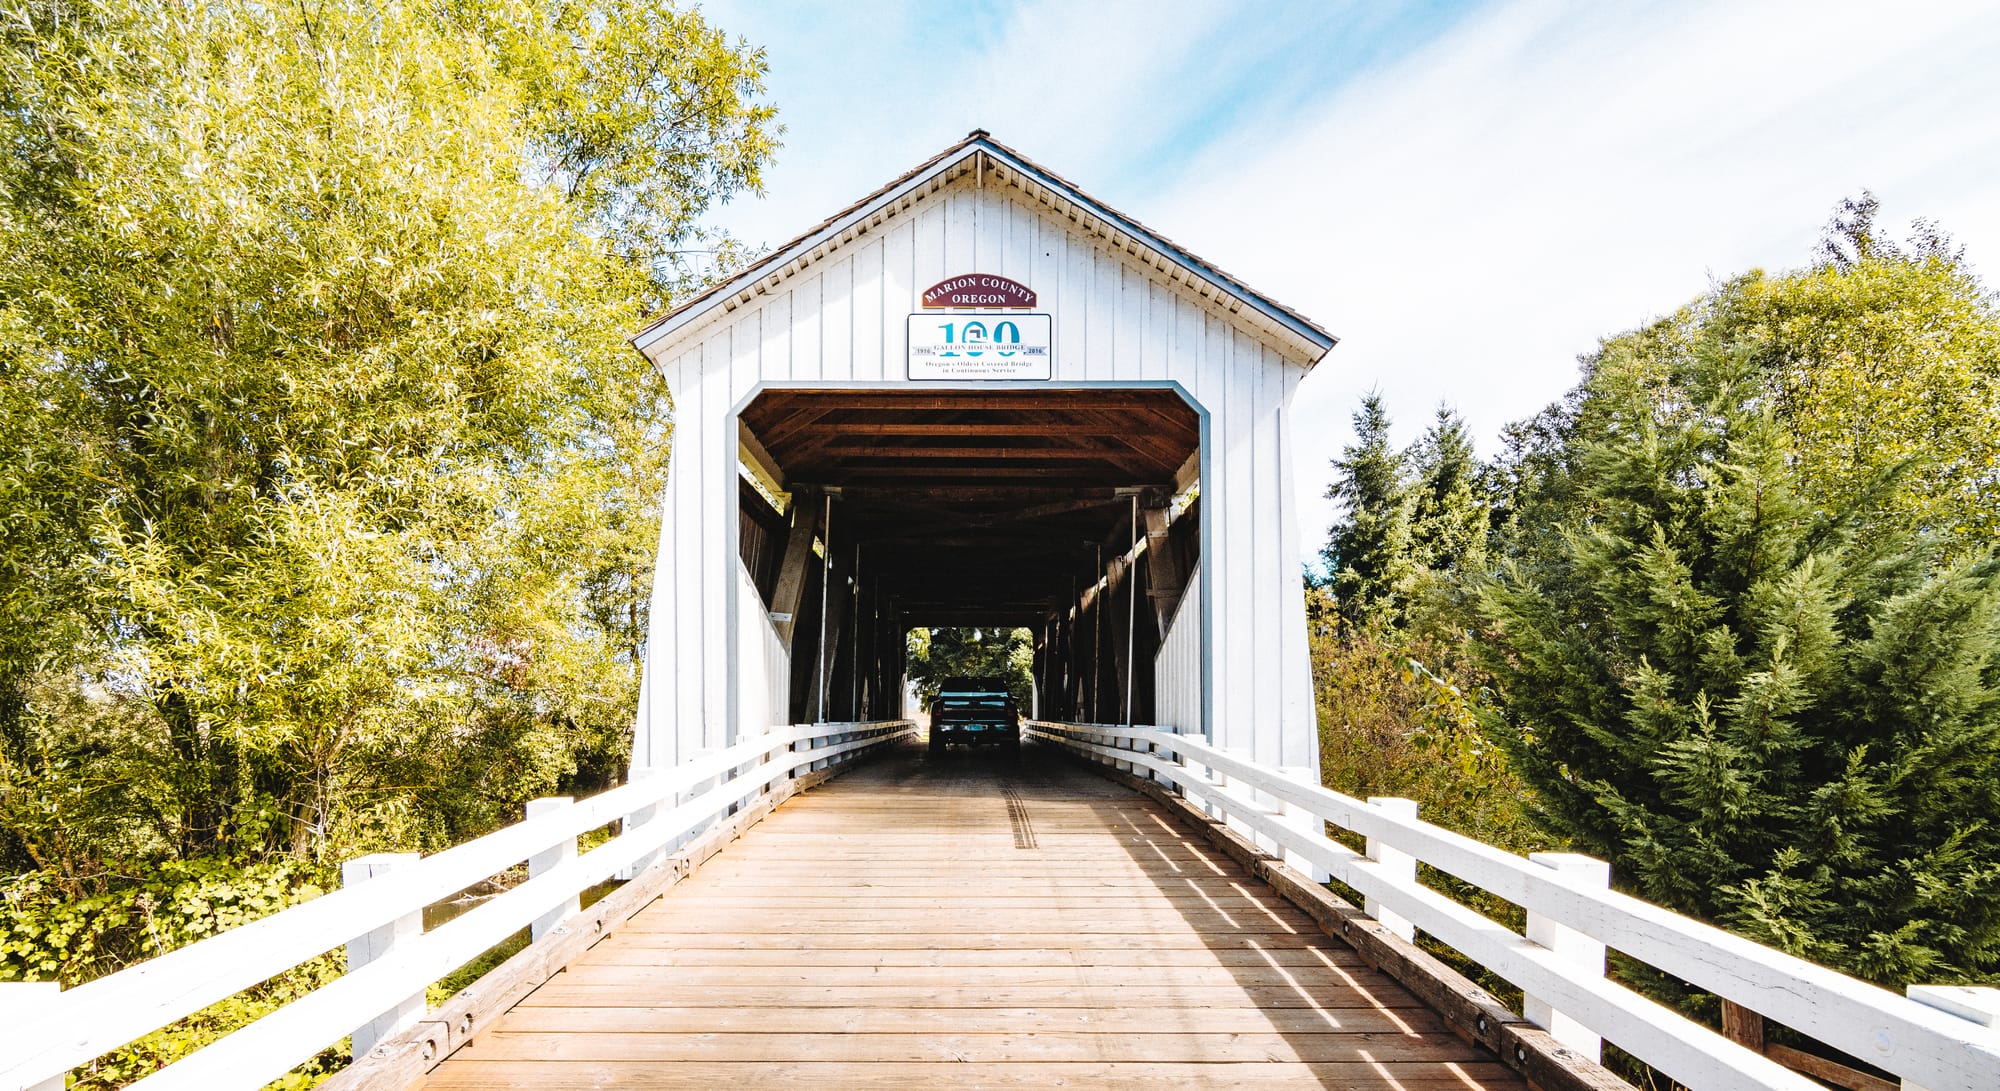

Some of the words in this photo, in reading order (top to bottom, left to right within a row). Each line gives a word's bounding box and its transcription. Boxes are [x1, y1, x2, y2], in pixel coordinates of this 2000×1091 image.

[924, 277, 977, 303] MARION
[981, 277, 1034, 302] COUNTY
[951, 294, 1006, 304] OREGON
[937, 320, 1020, 357] 100
